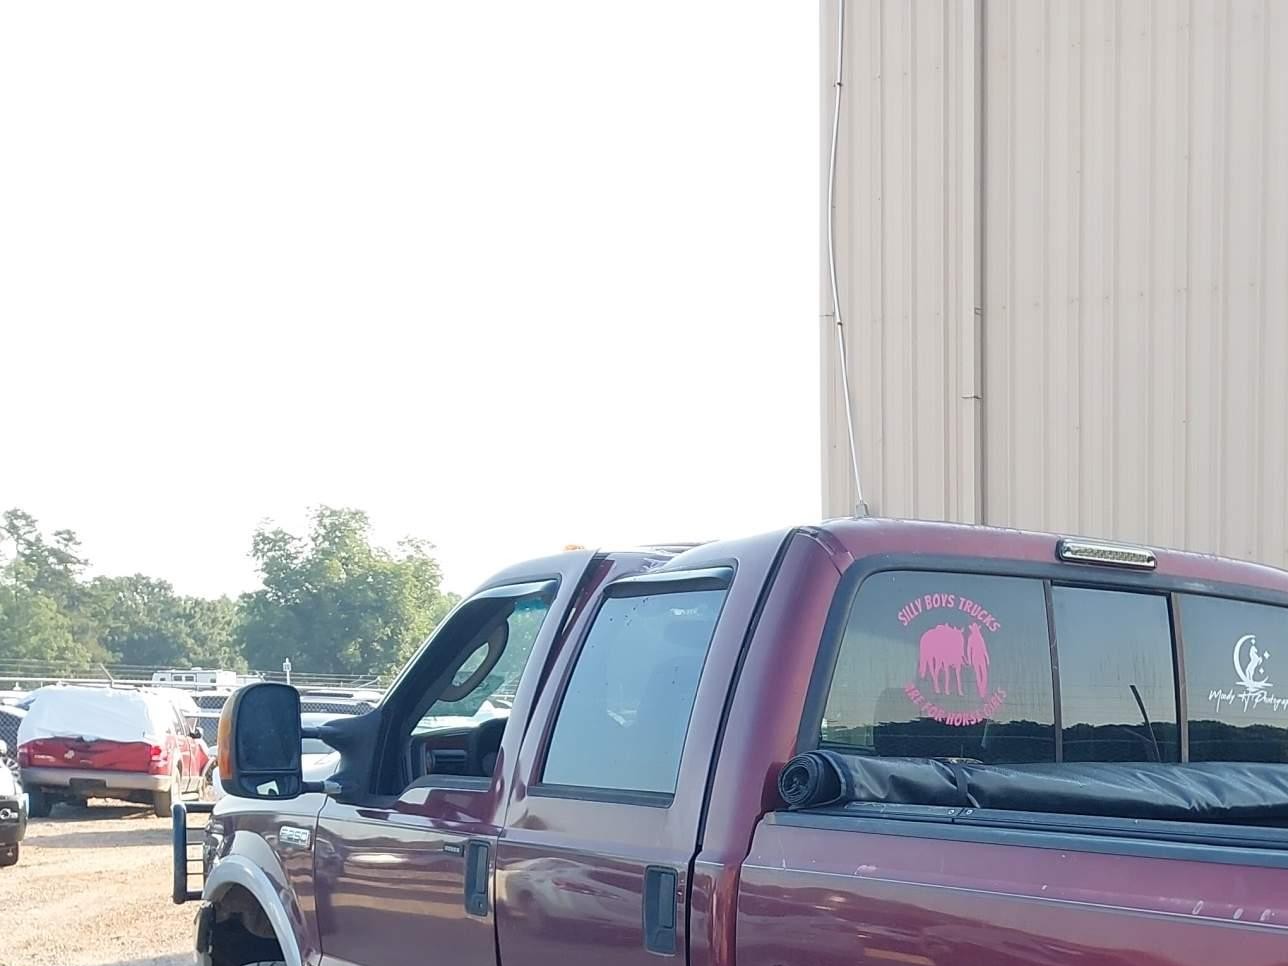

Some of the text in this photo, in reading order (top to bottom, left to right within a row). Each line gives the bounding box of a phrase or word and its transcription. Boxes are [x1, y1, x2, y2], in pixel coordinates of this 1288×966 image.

[897, 592, 1001, 633] SILLY BOYS TRUCKS
